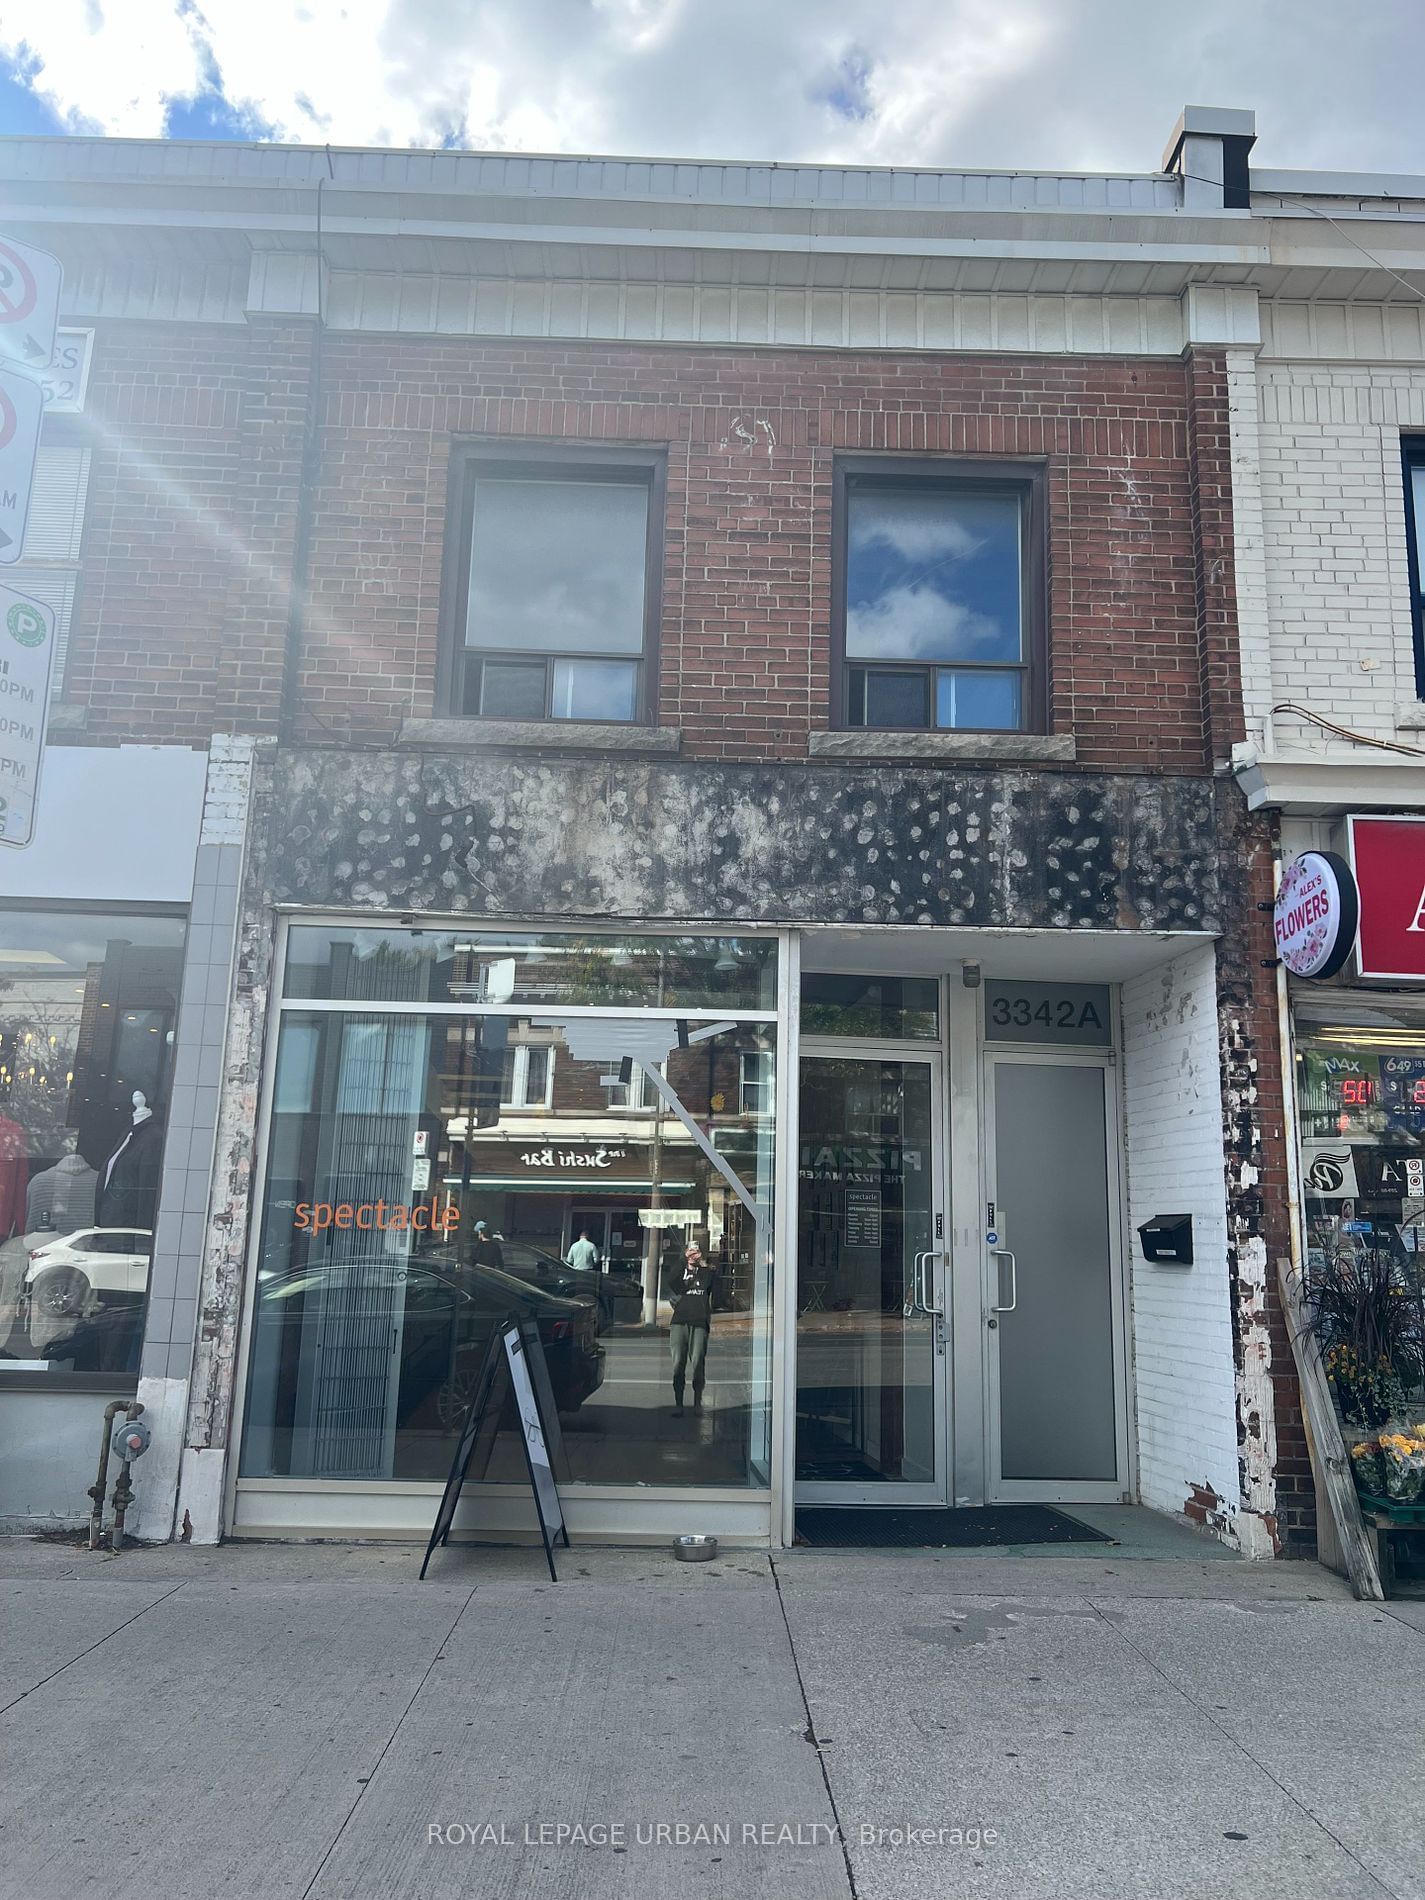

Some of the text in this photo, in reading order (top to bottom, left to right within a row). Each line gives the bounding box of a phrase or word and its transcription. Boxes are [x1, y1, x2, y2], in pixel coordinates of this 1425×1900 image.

[1299, 874, 1322, 898] ALEX'S
[1275, 889, 1329, 946] FLOWERS
[993, 998, 1102, 1028] 3342A
[293, 1196, 461, 1237] spectacle
